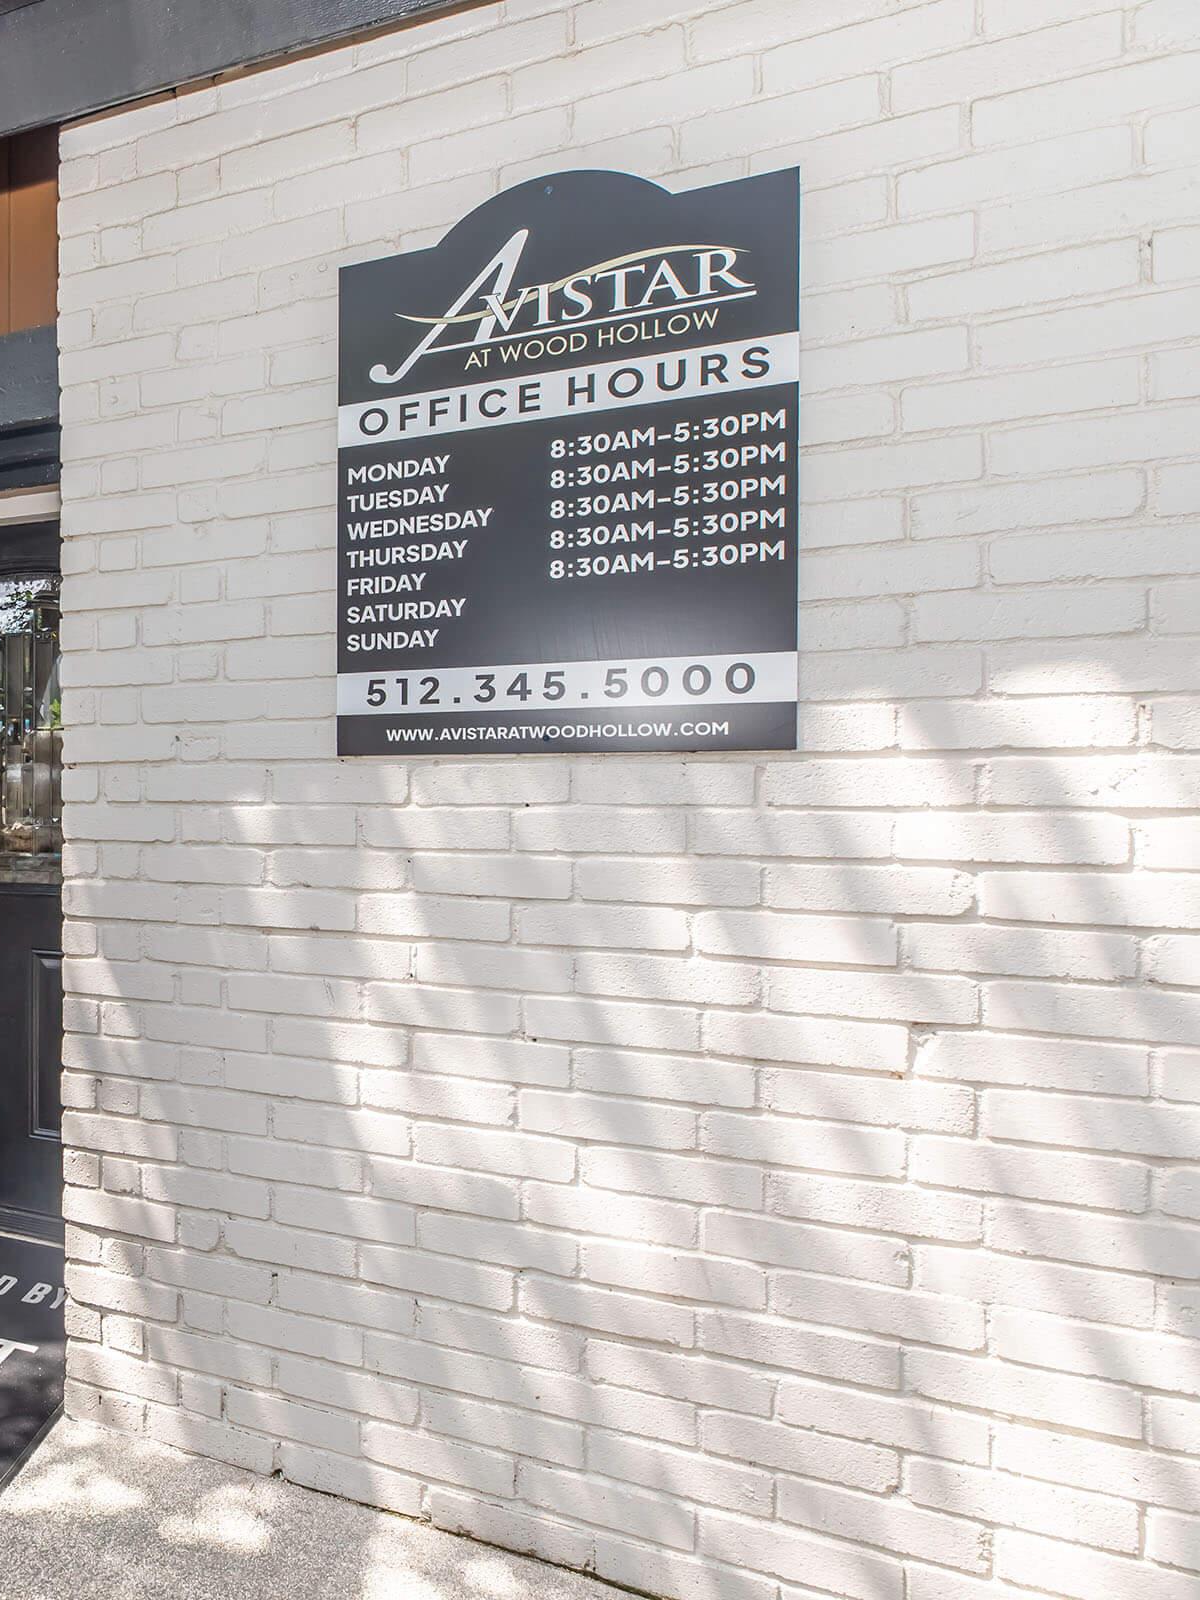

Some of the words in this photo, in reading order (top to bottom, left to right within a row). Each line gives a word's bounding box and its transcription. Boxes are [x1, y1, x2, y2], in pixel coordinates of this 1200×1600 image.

[369, 229, 756, 384] AVISTAR
[464, 350, 490, 371] AT
[499, 333, 589, 363] WOOD
[597, 307, 720, 347] HOLLOW
[358, 381, 542, 436] OFFICE
[567, 346, 771, 407] HOURS
[347, 454, 450, 486] MONDAY
[347, 483, 450, 514] TUESDAY
[347, 507, 493, 540] WEDNESDAY
[346, 539, 469, 569] THURSDAY
[346, 572, 427, 597] FRIDAY
[346, 598, 467, 624] SATURDAY
[346, 629, 440, 652] SUNDAY
[366, 662, 756, 707] 512.345.5000
[386, 721, 730, 742] WWW.AVISTARATWOODHOLLOW.COM
